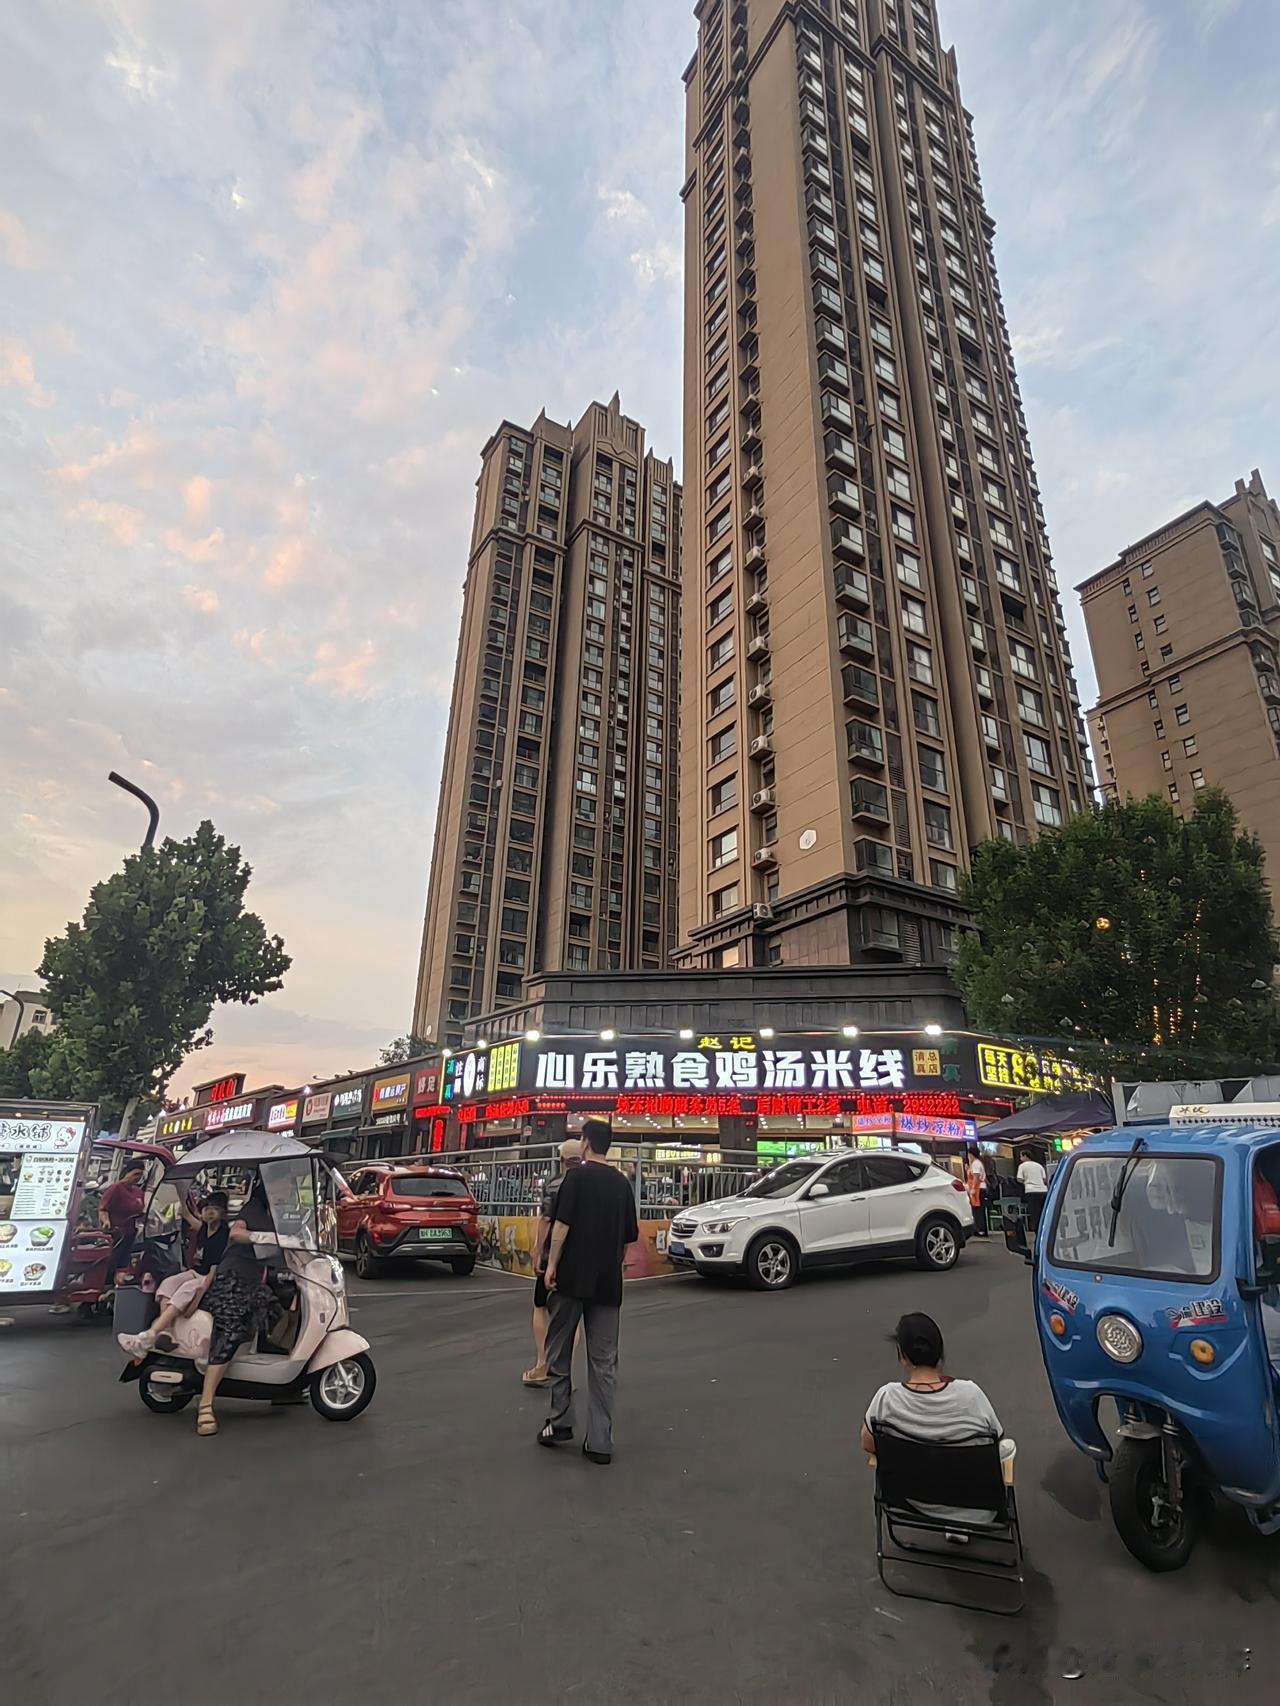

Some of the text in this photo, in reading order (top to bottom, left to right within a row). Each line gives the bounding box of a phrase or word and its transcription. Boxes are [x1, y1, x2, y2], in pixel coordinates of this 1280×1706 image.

[697, 1036, 757, 1050] 赵记
[984, 1049, 1008, 1067] 每天
[535, 1048, 906, 1088] 心乐熟食鸡汤米线
[900, 1115, 961, 1136] 爆炒凉粉
